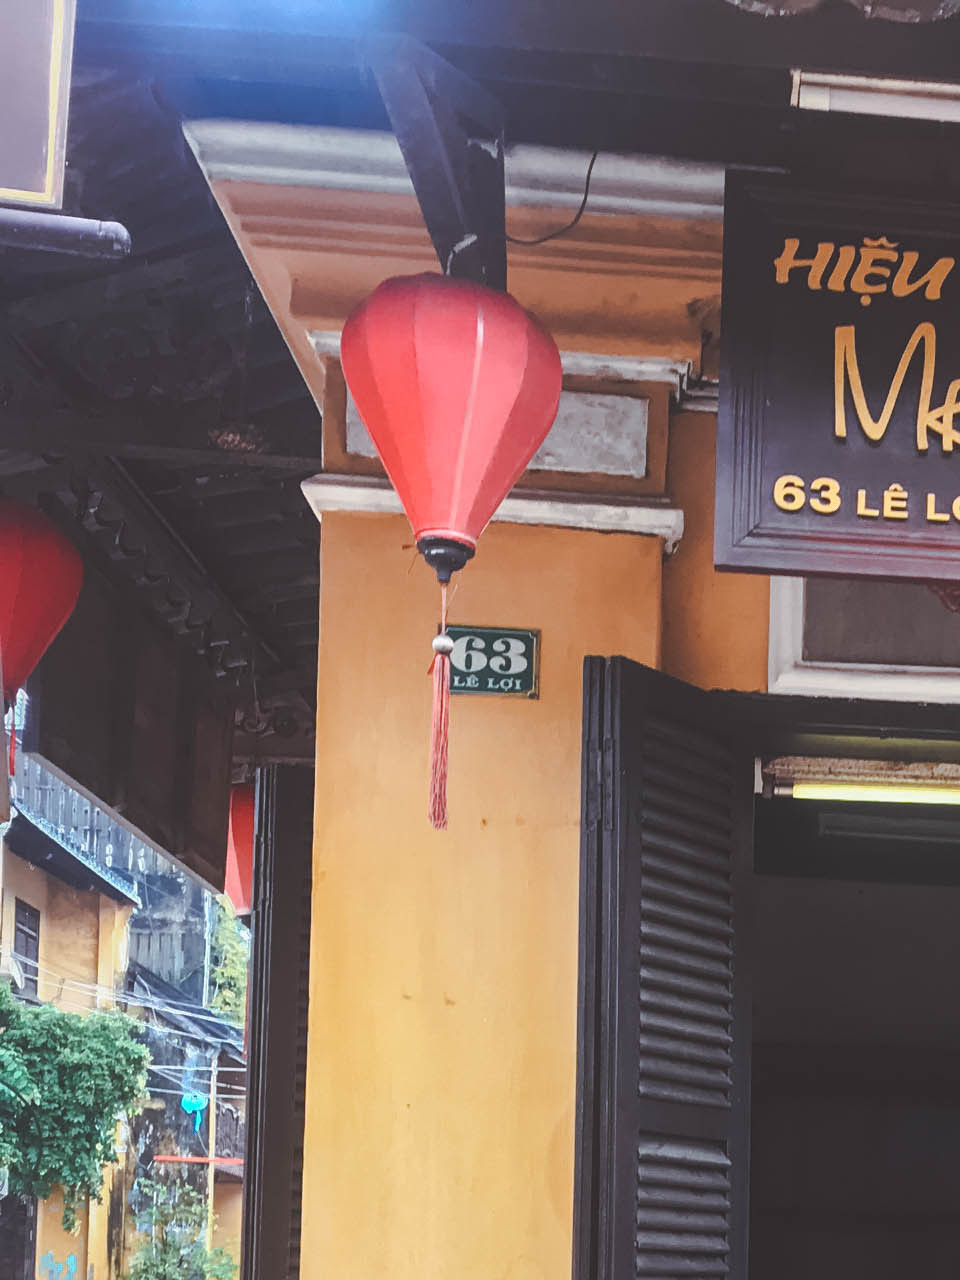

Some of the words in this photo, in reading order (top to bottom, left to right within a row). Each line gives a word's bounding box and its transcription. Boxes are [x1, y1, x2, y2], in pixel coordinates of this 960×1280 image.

[774, 237, 955, 306] HIỆU
[773, 474, 842, 514] 63
[856, 484, 909, 519] LÊ
[450, 635, 528, 675] 63
[453, 674, 480, 688] LÊ
[487, 677, 522, 691] LỢI
